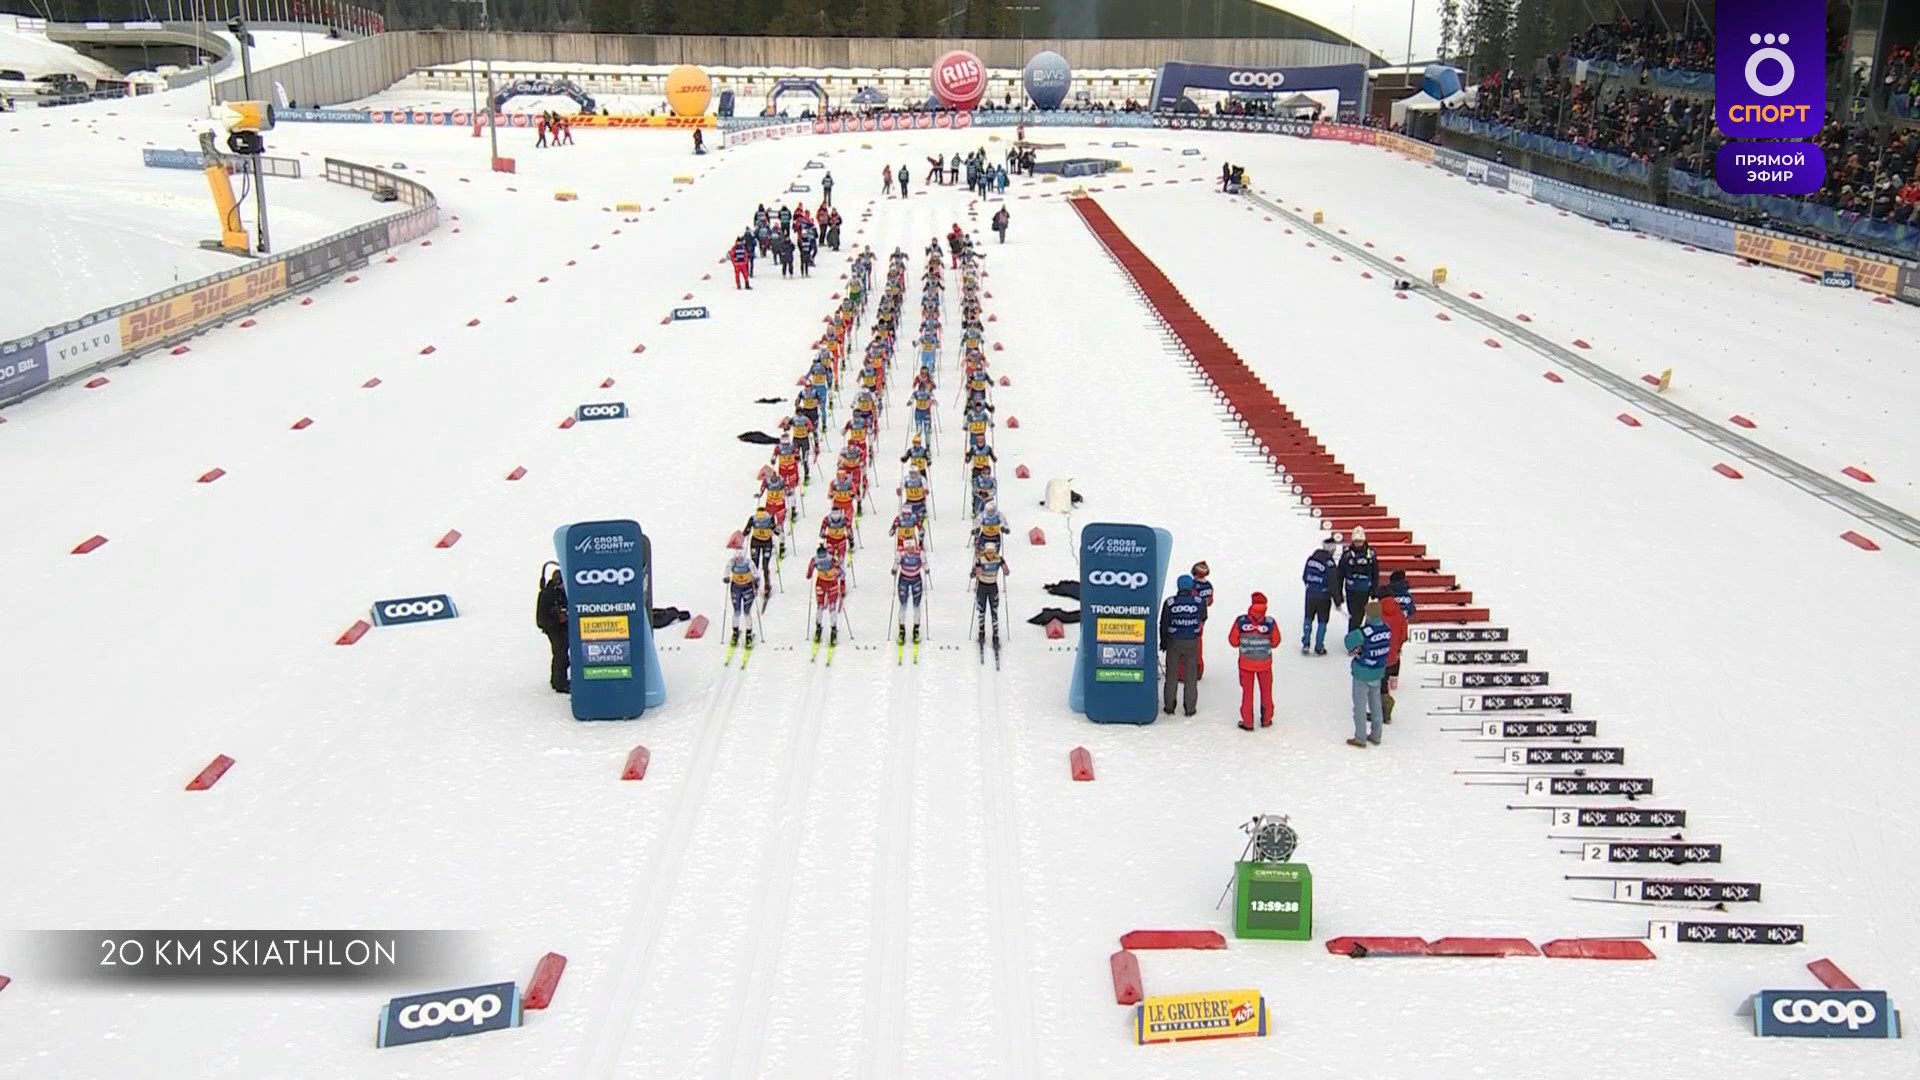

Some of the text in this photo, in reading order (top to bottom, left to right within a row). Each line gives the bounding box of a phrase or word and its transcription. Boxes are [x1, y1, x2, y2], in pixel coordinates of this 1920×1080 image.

[942, 60, 978, 84] RIIS
[1229, 72, 1285, 88] coop
[517, 84, 549, 92] CRAFT
[606, 118, 650, 127] DHL
[665, 118, 708, 127] DHL
[1738, 233, 1773, 258] DHL
[1786, 245, 1827, 271] DHL
[1843, 257, 1889, 288] DHL
[245, 266, 281, 298] DHL
[1825, 279, 1850, 287] coop
[191, 283, 233, 320] DHL
[677, 308, 704, 318] coop
[130, 303, 177, 343] DHL
[59, 334, 111, 361] VOLVO
[18, 359, 39, 373] BIL
[583, 405, 621, 417] coop
[594, 542, 634, 550] COUNTRY
[1107, 545, 1147, 553] COUNTRY
[575, 567, 635, 585] coop
[1089, 570, 1148, 589] coop
[384, 599, 444, 618] coop
[575, 603, 636, 613] TRONDHEIM
[1090, 605, 1150, 615] TRONDHEIM
[1171, 605, 1197, 613] coop
[1414, 632, 1426, 640] 10
[600, 645, 623, 655] VVS
[1116, 648, 1137, 657] VVS
[1432, 653, 1439, 662] 9
[1449, 675, 1457, 685] 8
[1468, 699, 1476, 708] 7
[1489, 725, 1497, 735] 6
[1512, 751, 1520, 762] 5
[1535, 782, 1543, 792] 4
[1562, 812, 1570, 824] 3
[1591, 847, 1601, 859] 2
[1625, 885, 1632, 897] 1
[1251, 901, 1299, 912] 13:59:38
[1659, 926, 1667, 939] 1
[399, 993, 501, 1030] coop
[1149, 998, 1230, 1022] LE GRUYÈRE
[1234, 1006, 1255, 1024] AOP
[1773, 998, 1876, 1030] coop
[1153, 1020, 1227, 1032] SWITZERLAND
